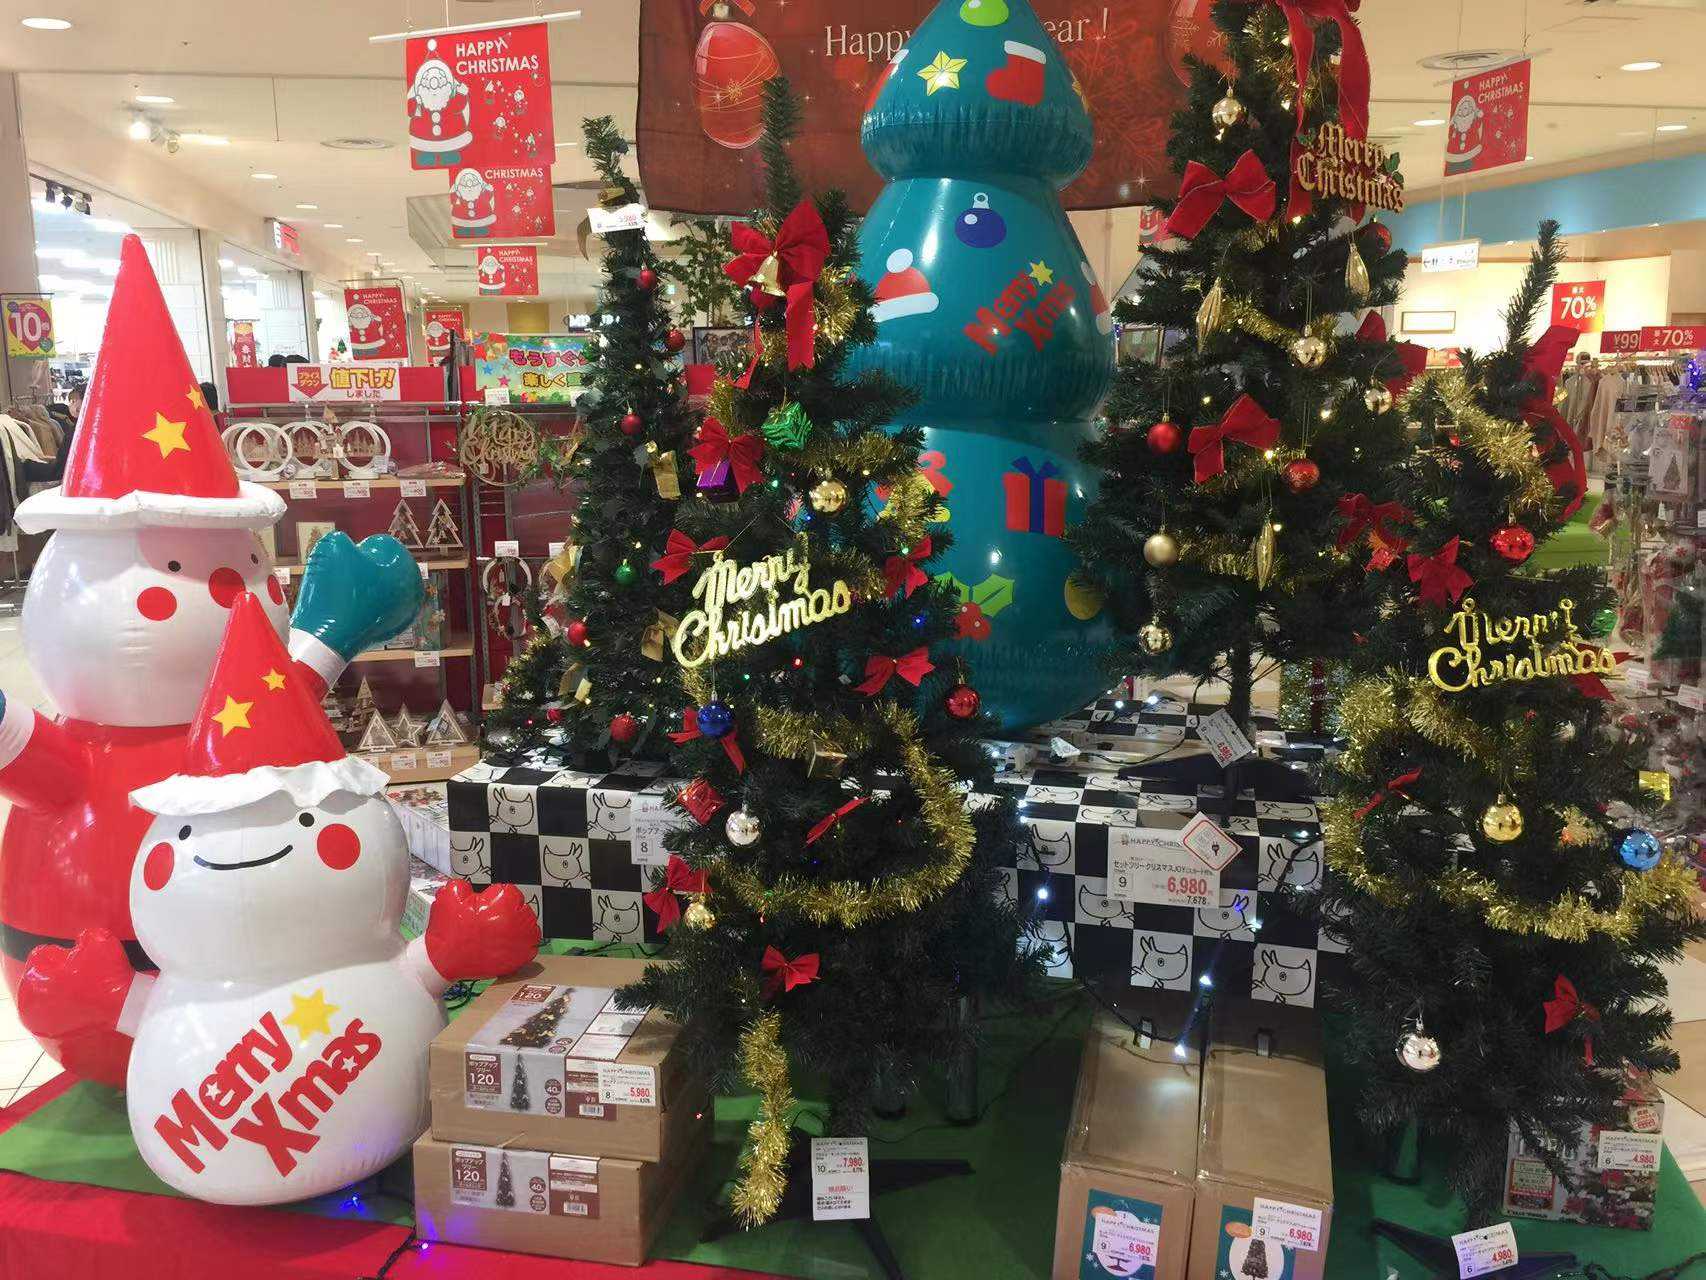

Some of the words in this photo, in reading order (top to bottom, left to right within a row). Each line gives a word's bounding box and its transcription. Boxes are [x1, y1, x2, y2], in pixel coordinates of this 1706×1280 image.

[456, 36, 507, 57] HAPPY
[825, 24, 913, 62] Happ
[1043, 17, 1090, 43] ear
[456, 55, 539, 75] CHRISTMAS
[1479, 74, 1508, 90] HAPPY
[1478, 82, 1524, 104] CHRISTMAS
[1316, 121, 1385, 175] Merry
[485, 168, 544, 179] CHRISTMAS
[1297, 152, 1405, 212] Christmas
[498, 255, 533, 263] CHRISTMAS
[963, 271, 1036, 358] Merry
[1013, 278, 1077, 352] Xmas
[1561, 296, 1597, 320] 70%
[1614, 333, 1641, 349] ¥99
[1662, 330, 1694, 346] 70%
[298, 371, 319, 380] プライス
[330, 366, 396, 389] 値下げ!
[346, 389, 381, 398] しました
[691, 533, 811, 613] Merry
[670, 580, 852, 669] Christmas
[1443, 600, 1582, 650] Merry
[1428, 641, 1617, 692] Christmas
[640, 841, 648, 853] 8
[1130, 838, 1158, 847] HAPPY
[1118, 876, 1128, 888] 9
[1167, 877, 1208, 896] 6,980
[470, 1072, 495, 1085] 120
[154, 1010, 293, 1174] Merry
[230, 1017, 383, 1178] Xmas
[630, 1087, 651, 1098] 5,980
[843, 1157, 864, 1168] 7,980
[1633, 1154, 1655, 1164] 4,980
[456, 1169, 480, 1182] 120
[817, 1165, 826, 1174] 10
[1260, 1204, 1281, 1212] HAPPY
[1281, 1207, 1317, 1219] CHRISTMAS
[1259, 1228, 1266, 1236] 9
[1289, 1228, 1313, 1242] 6,980
[1101, 1242, 1107, 1250] 9
[1129, 1242, 1151, 1256] 6,980
[1467, 1265, 1473, 1273] 6
